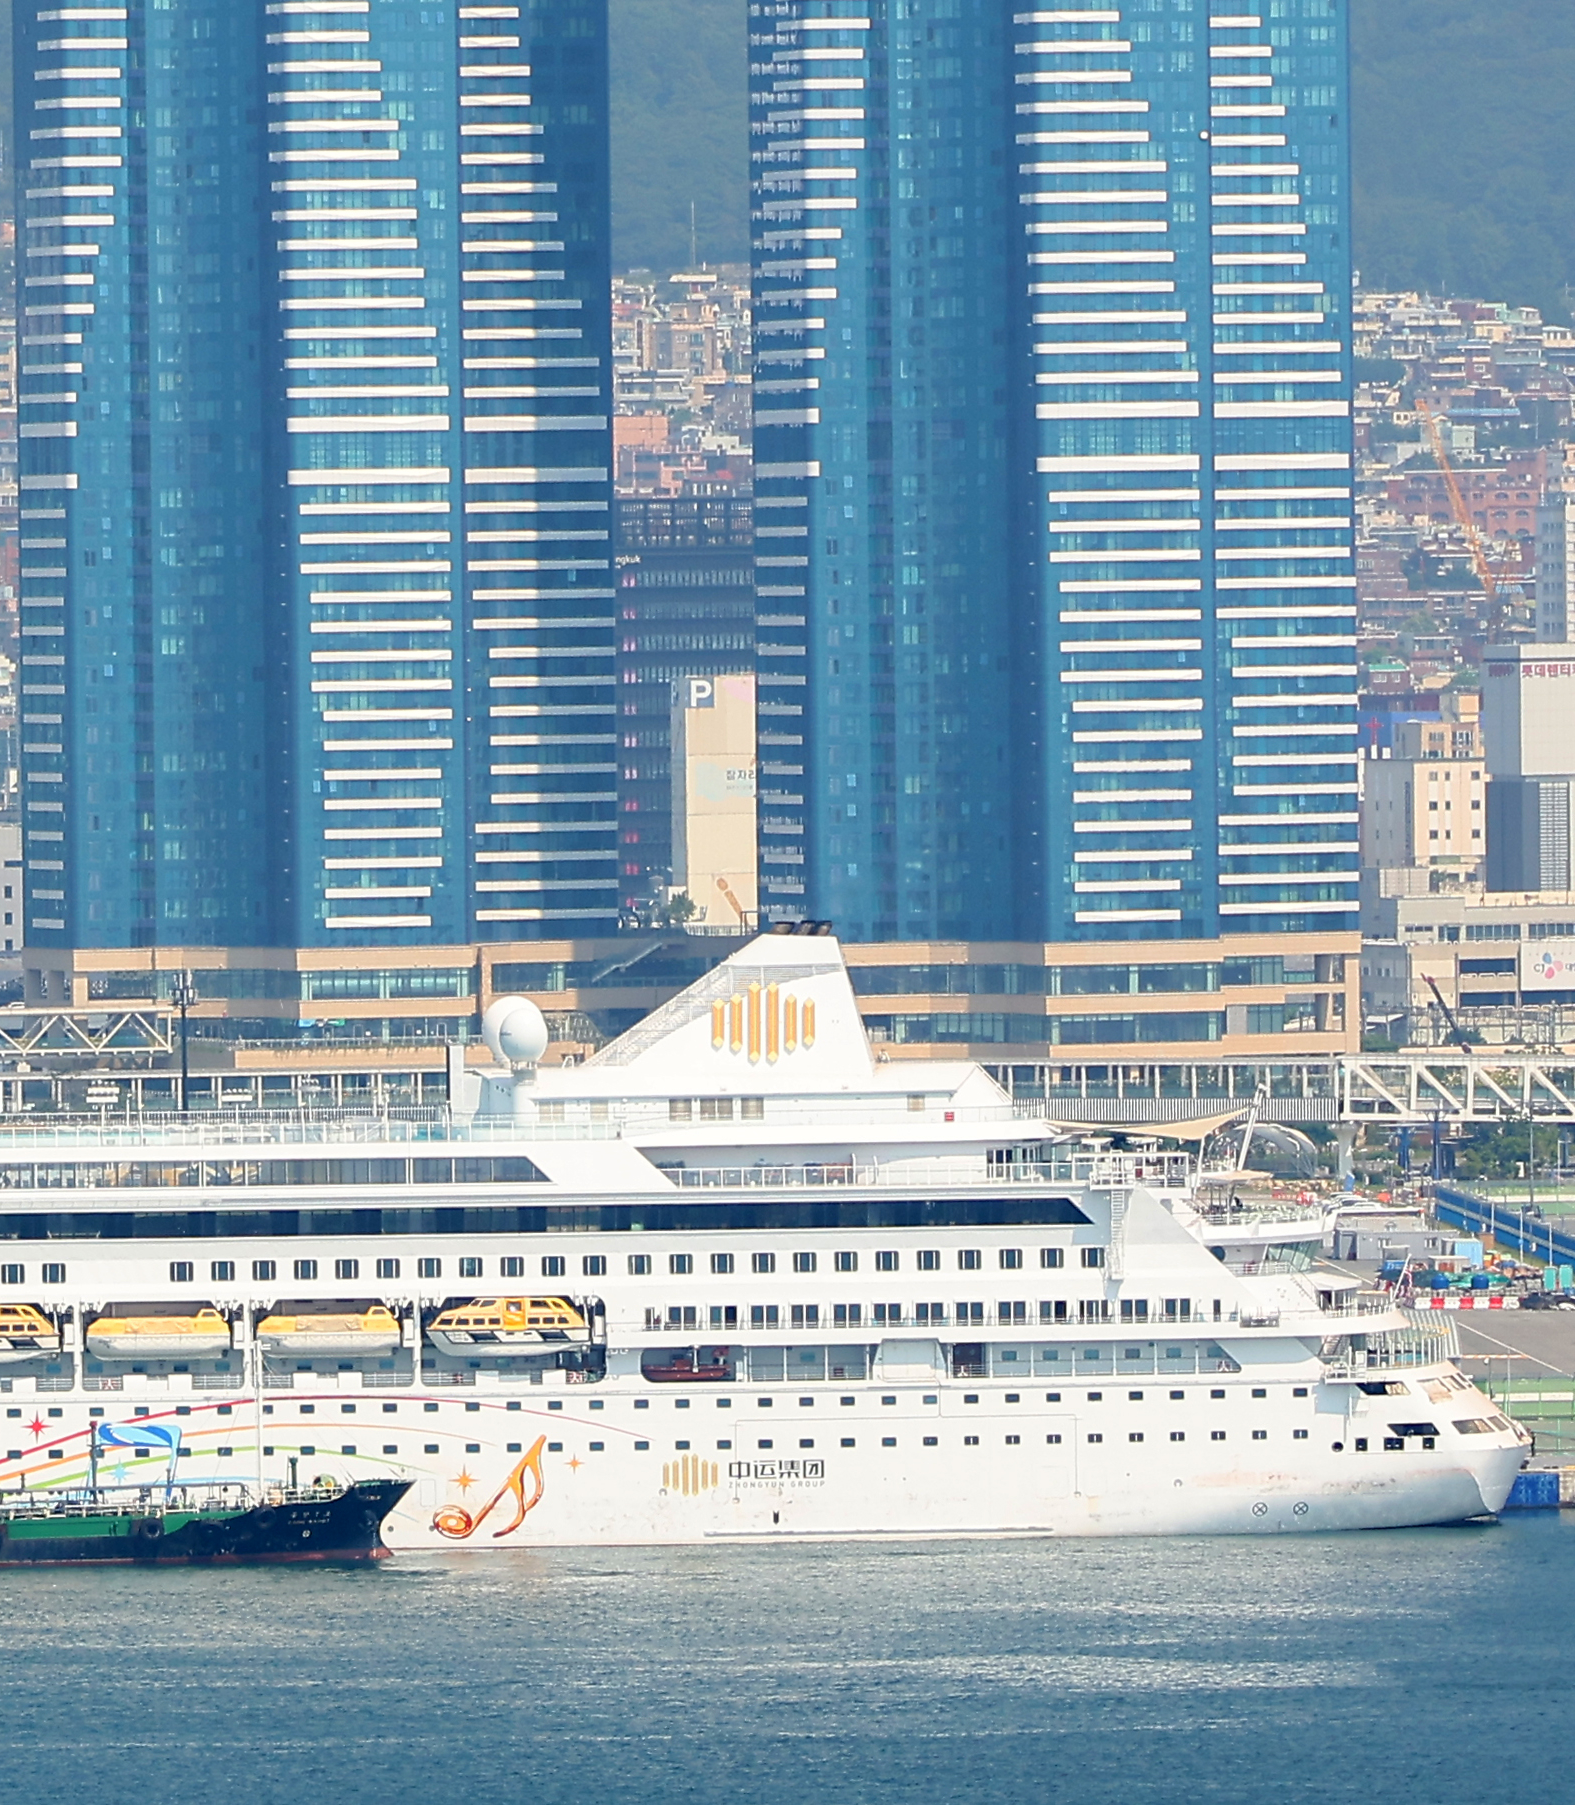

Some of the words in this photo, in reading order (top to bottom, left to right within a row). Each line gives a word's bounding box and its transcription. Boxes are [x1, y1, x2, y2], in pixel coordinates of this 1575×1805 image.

[690, 680, 712, 707] P
[1533, 963, 1545, 974] CJ
[729, 1459, 824, 1479] 中运集团
